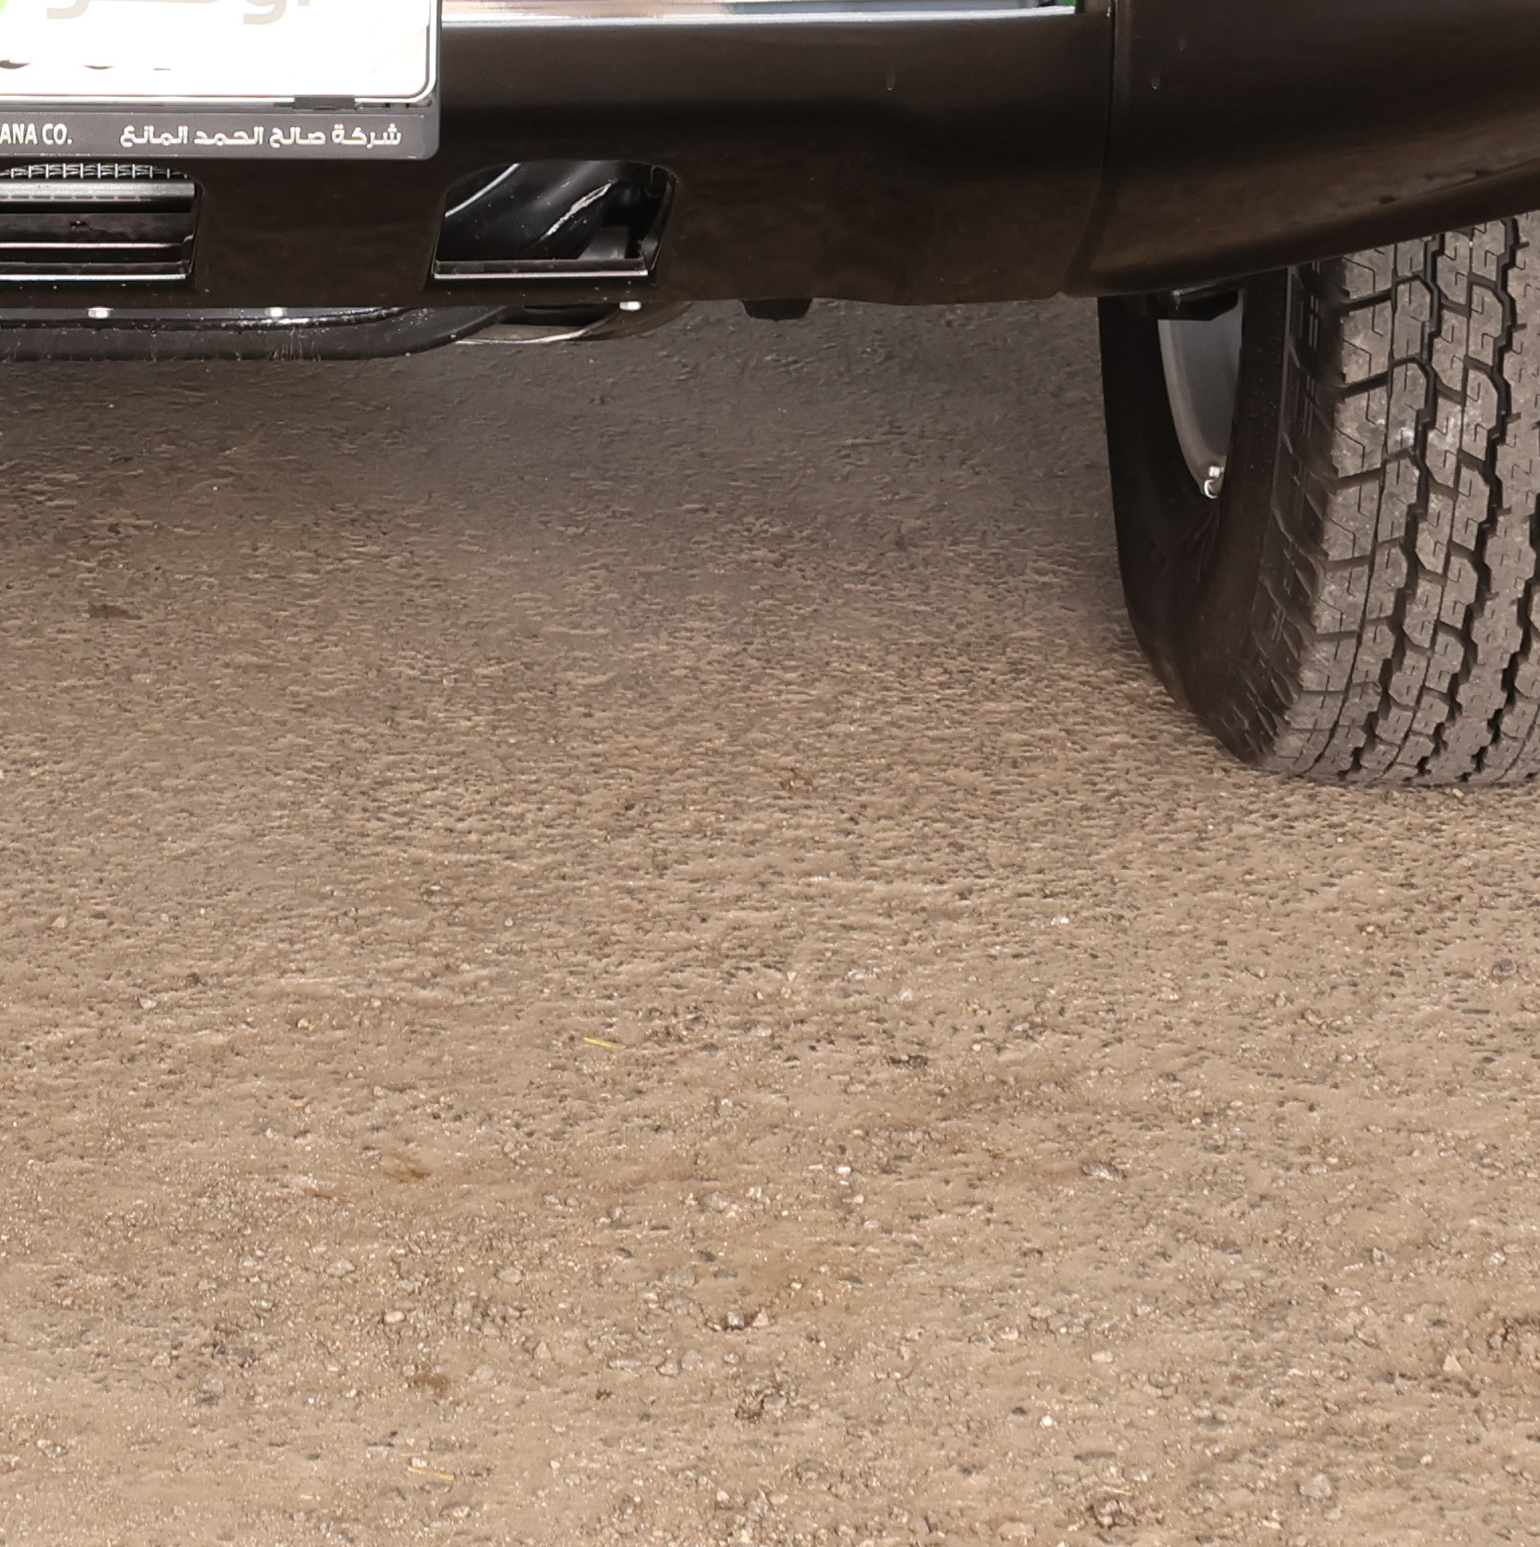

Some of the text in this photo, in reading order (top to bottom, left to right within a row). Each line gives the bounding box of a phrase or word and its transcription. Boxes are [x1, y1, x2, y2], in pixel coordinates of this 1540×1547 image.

[41, 122, 73, 145] CO.
[120, 122, 402, 149] شركة صالح الحمد المانع
